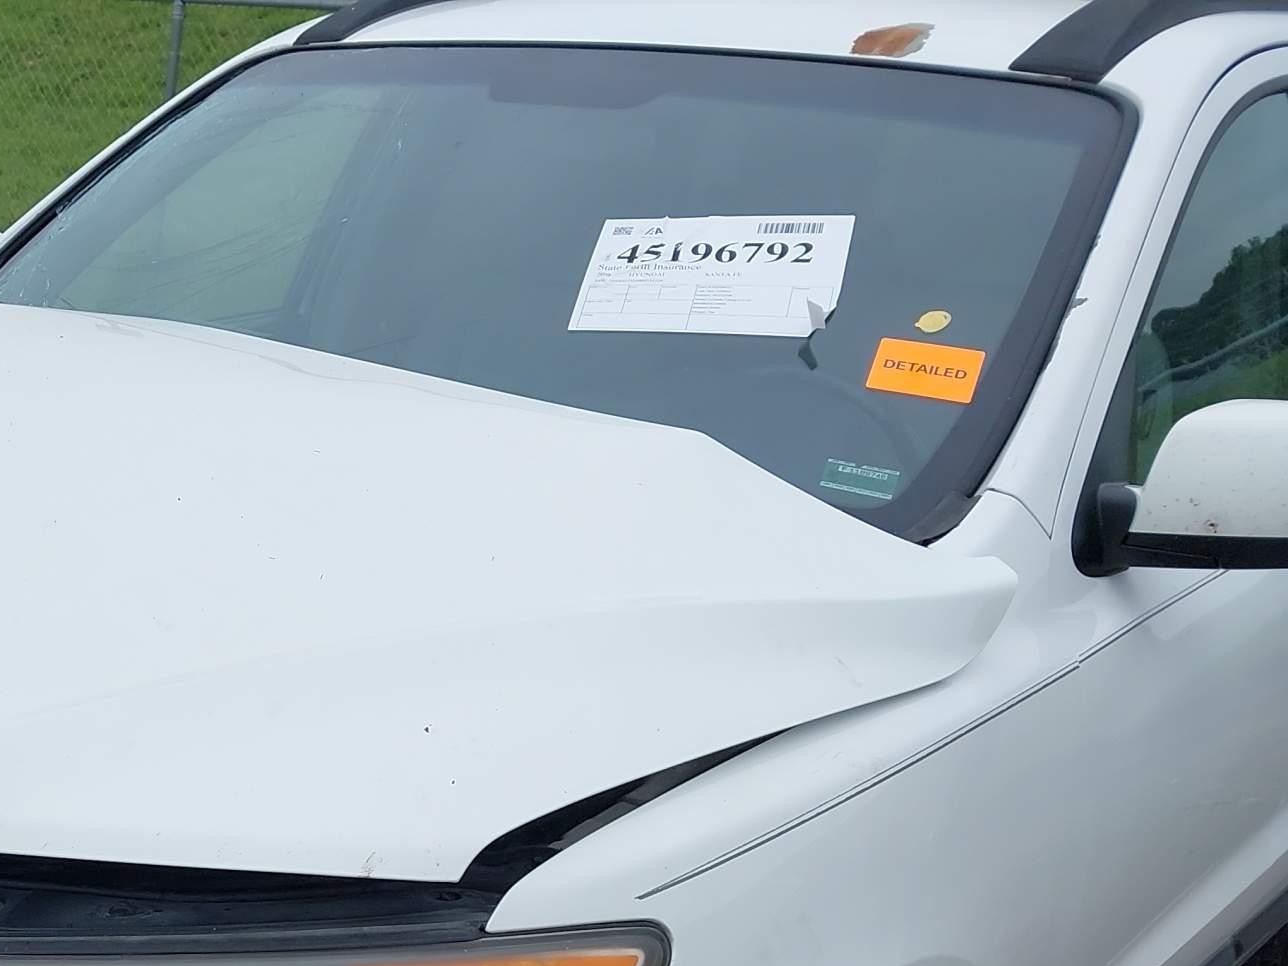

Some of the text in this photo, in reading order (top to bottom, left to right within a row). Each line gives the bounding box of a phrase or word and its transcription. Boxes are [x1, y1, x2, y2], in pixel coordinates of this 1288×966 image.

[617, 241, 815, 263] 45196792
[598, 263, 622, 271] State
[653, 263, 702, 271] Insurance
[883, 359, 968, 379] DETAILED
